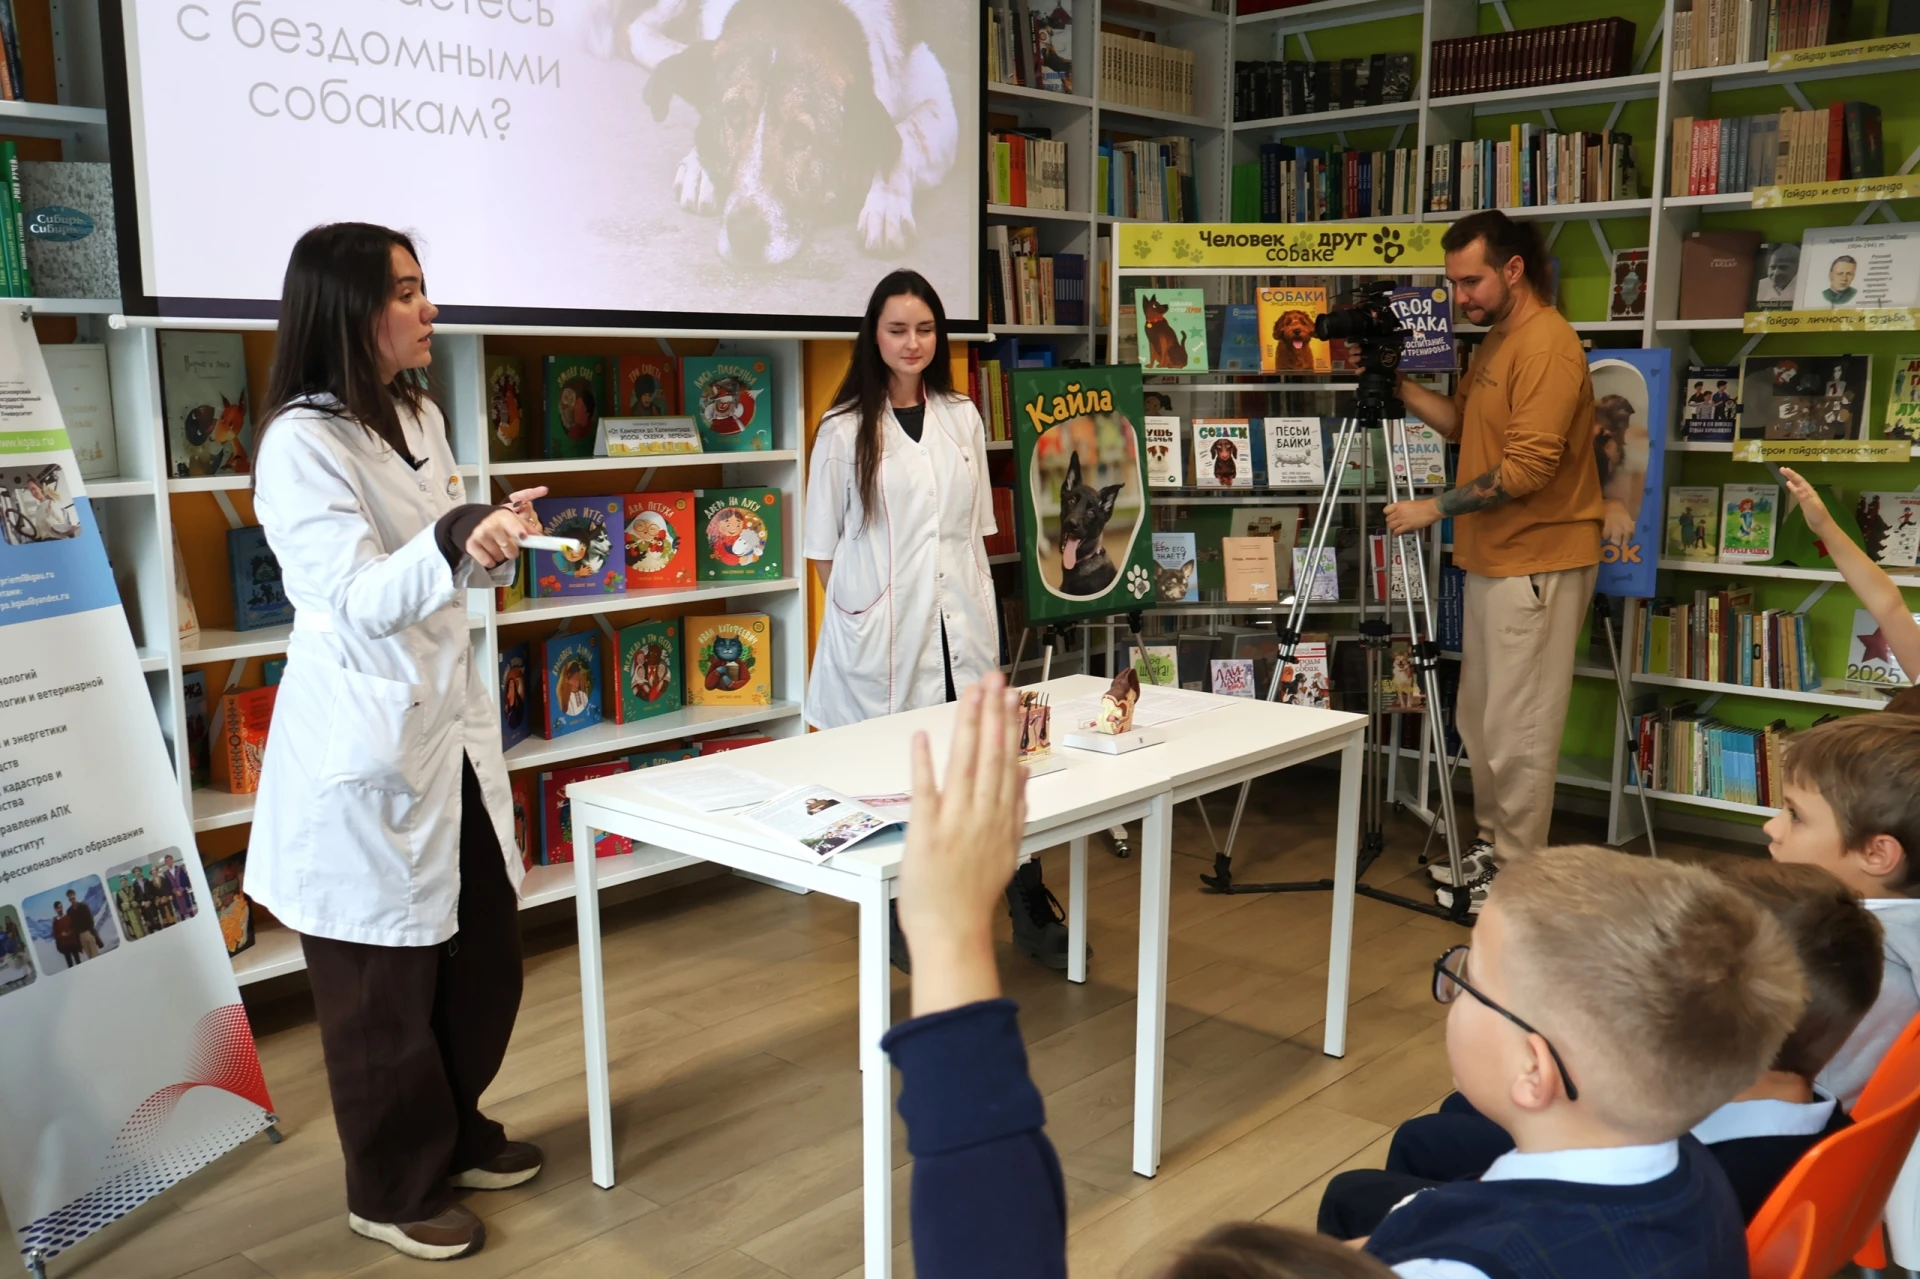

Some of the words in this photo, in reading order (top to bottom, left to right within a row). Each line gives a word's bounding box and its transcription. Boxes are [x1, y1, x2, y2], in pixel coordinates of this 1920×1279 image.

[176, 4, 211, 42] с
[231, 0, 561, 88] бездомными
[1794, 49, 1828, 62] Гайдар
[248, 78, 512, 141] собакам?
[1783, 188, 1818, 200] Гайдар
[1832, 186, 1849, 197] его
[1854, 182, 1902, 194] команда
[1199, 230, 1285, 248] Человек
[1318, 232, 1367, 251] друг
[1266, 244, 1334, 263] собаке
[1261, 290, 1324, 302] СОБАКИ
[1389, 298, 1432, 319] ТВОЯ
[1399, 316, 1448, 333] ОБАКА
[1405, 337, 1447, 349] ОСПИТАНИЕ
[1407, 344, 1451, 357] ТРЕНИРОВКА
[1025, 384, 1114, 433] Кайла
[1146, 428, 1174, 437] УШЬ
[1199, 426, 1248, 440] СОБАКИ
[1276, 437, 1312, 449] БАЙКИ
[628, 503, 643, 516] ДВА
[648, 502, 674, 518] ПЕТУХА
[704, 499, 725, 520] ДВЕРЬ
[728, 496, 739, 506] НА
[740, 496, 761, 512] ЛУГУ
[544, 507, 577, 536] МАЛЬЧИК
[1600, 544, 1642, 563] ОК
[697, 631, 717, 646] ИВАН
[718, 622, 759, 645] КОТОФЕЕВИЧ
[1846, 664, 1901, 684] 2025
[37, 677, 104, 700] ветеринарной
[3, 739, 10, 747] и
[12, 724, 68, 746] энергетики
[3, 772, 54, 794] кадастров
[56, 770, 63, 778] и
[50, 804, 72, 819] АПК
[1, 837, 45, 859] институт
[85, 826, 145, 854] образования
